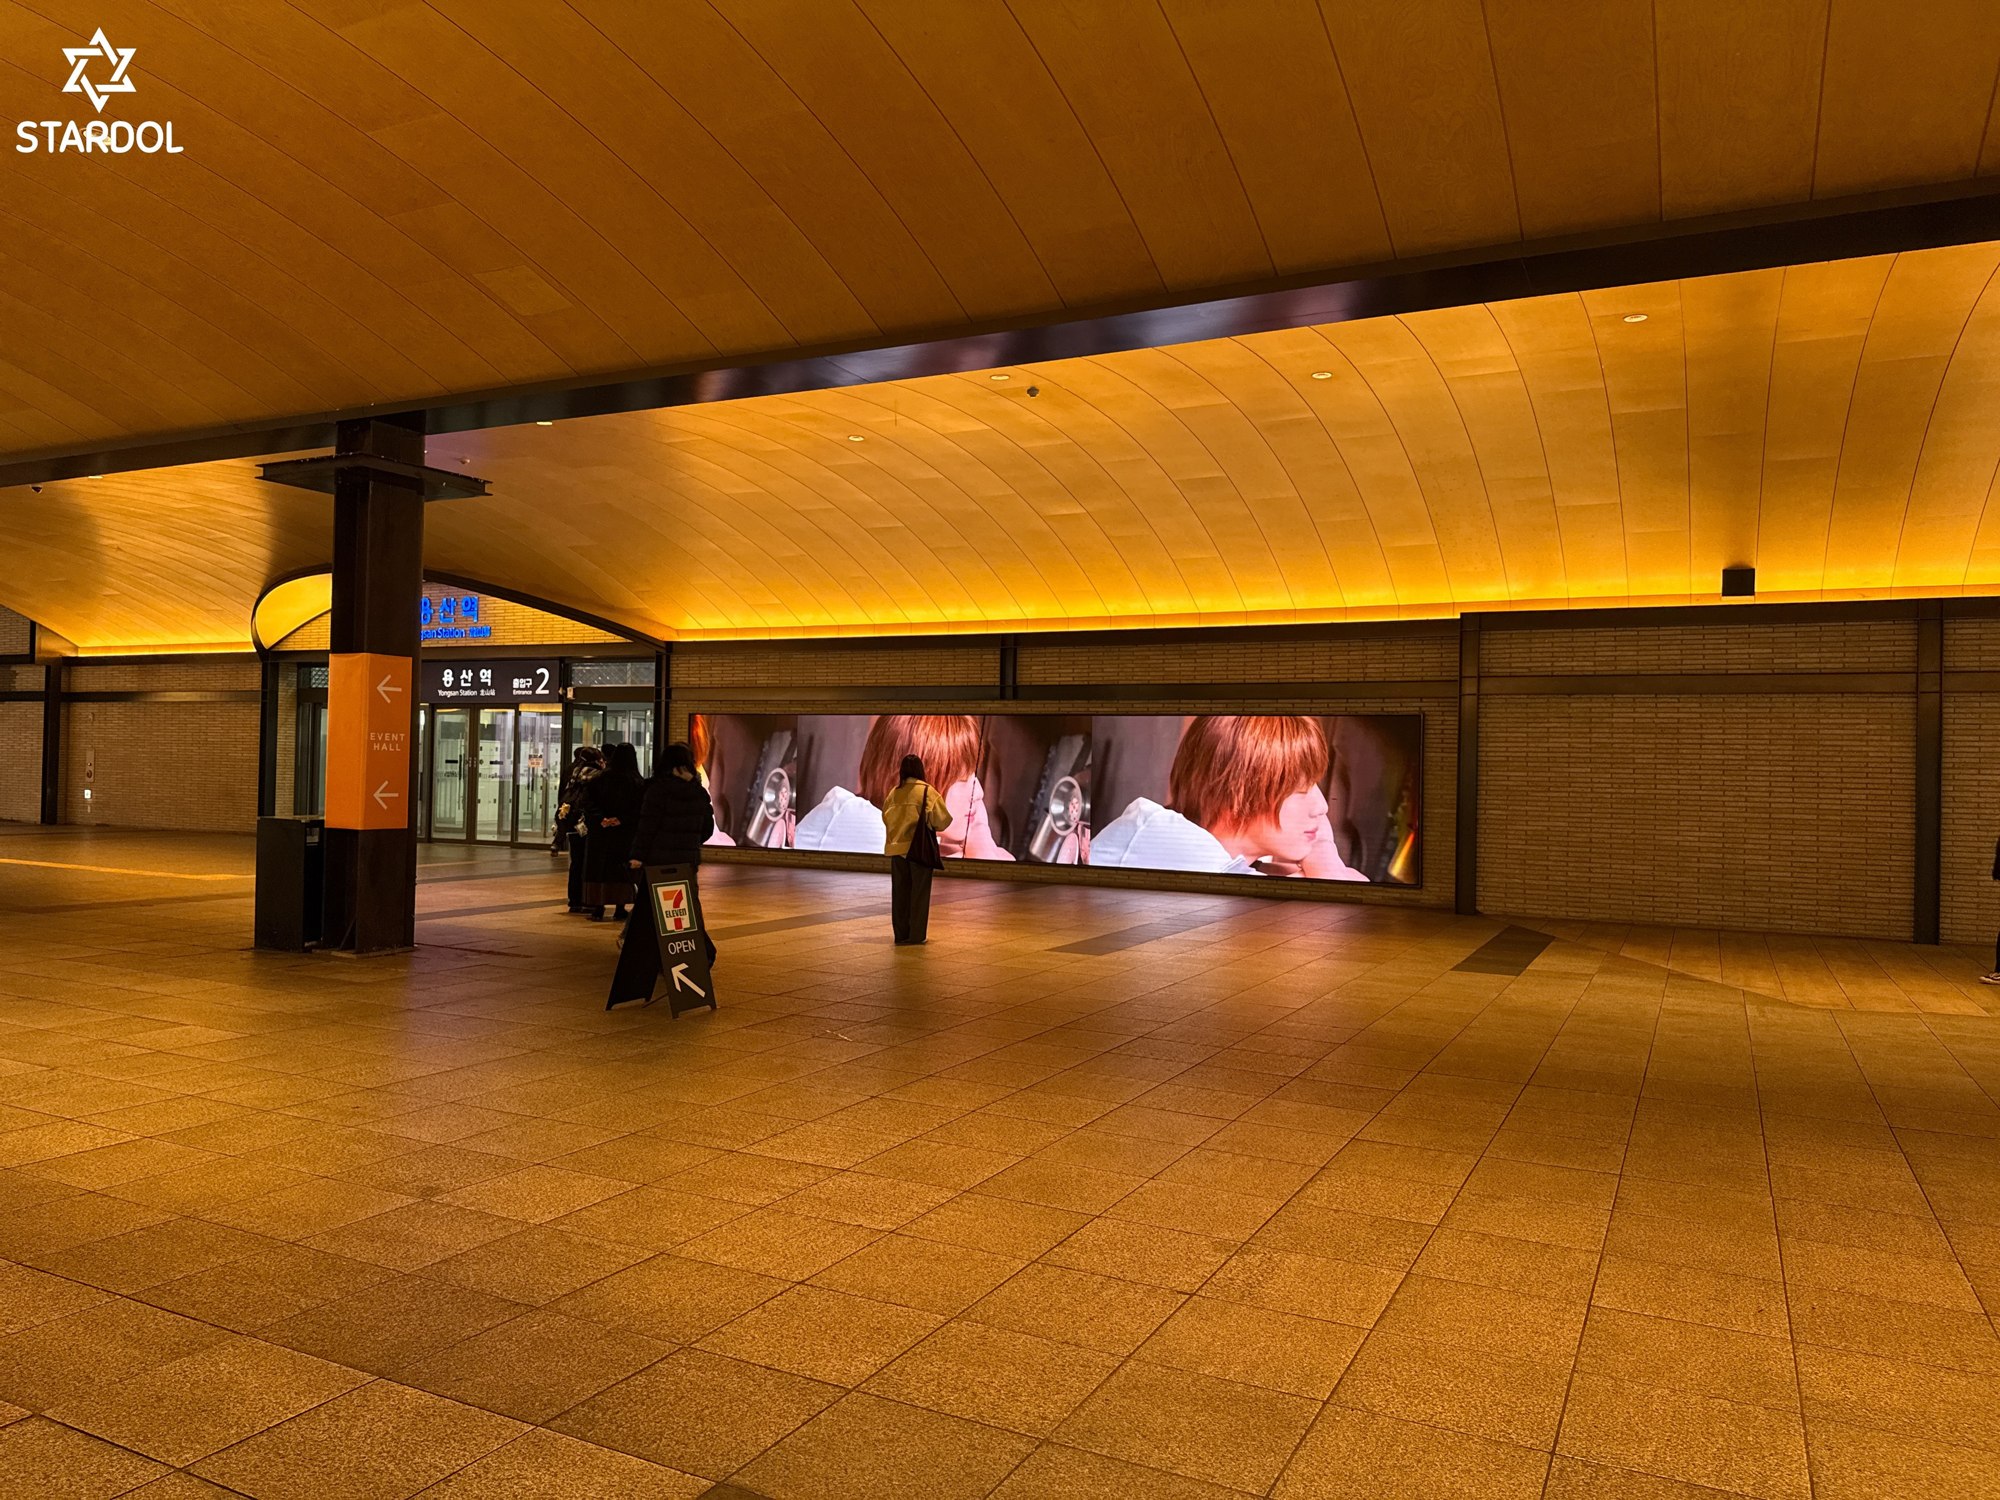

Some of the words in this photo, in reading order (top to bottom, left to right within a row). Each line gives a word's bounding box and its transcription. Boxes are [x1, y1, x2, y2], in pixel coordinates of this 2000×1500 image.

[437, 627, 465, 638] Station
[442, 668, 492, 688] 용산역
[512, 678, 533, 689] 출입구
[535, 667, 550, 695] 2
[438, 689, 459, 698] Yongsan
[459, 689, 478, 697] Station
[370, 732, 406, 742] EVENT
[373, 743, 401, 752] HALL
[668, 939, 696, 955] OPEN
